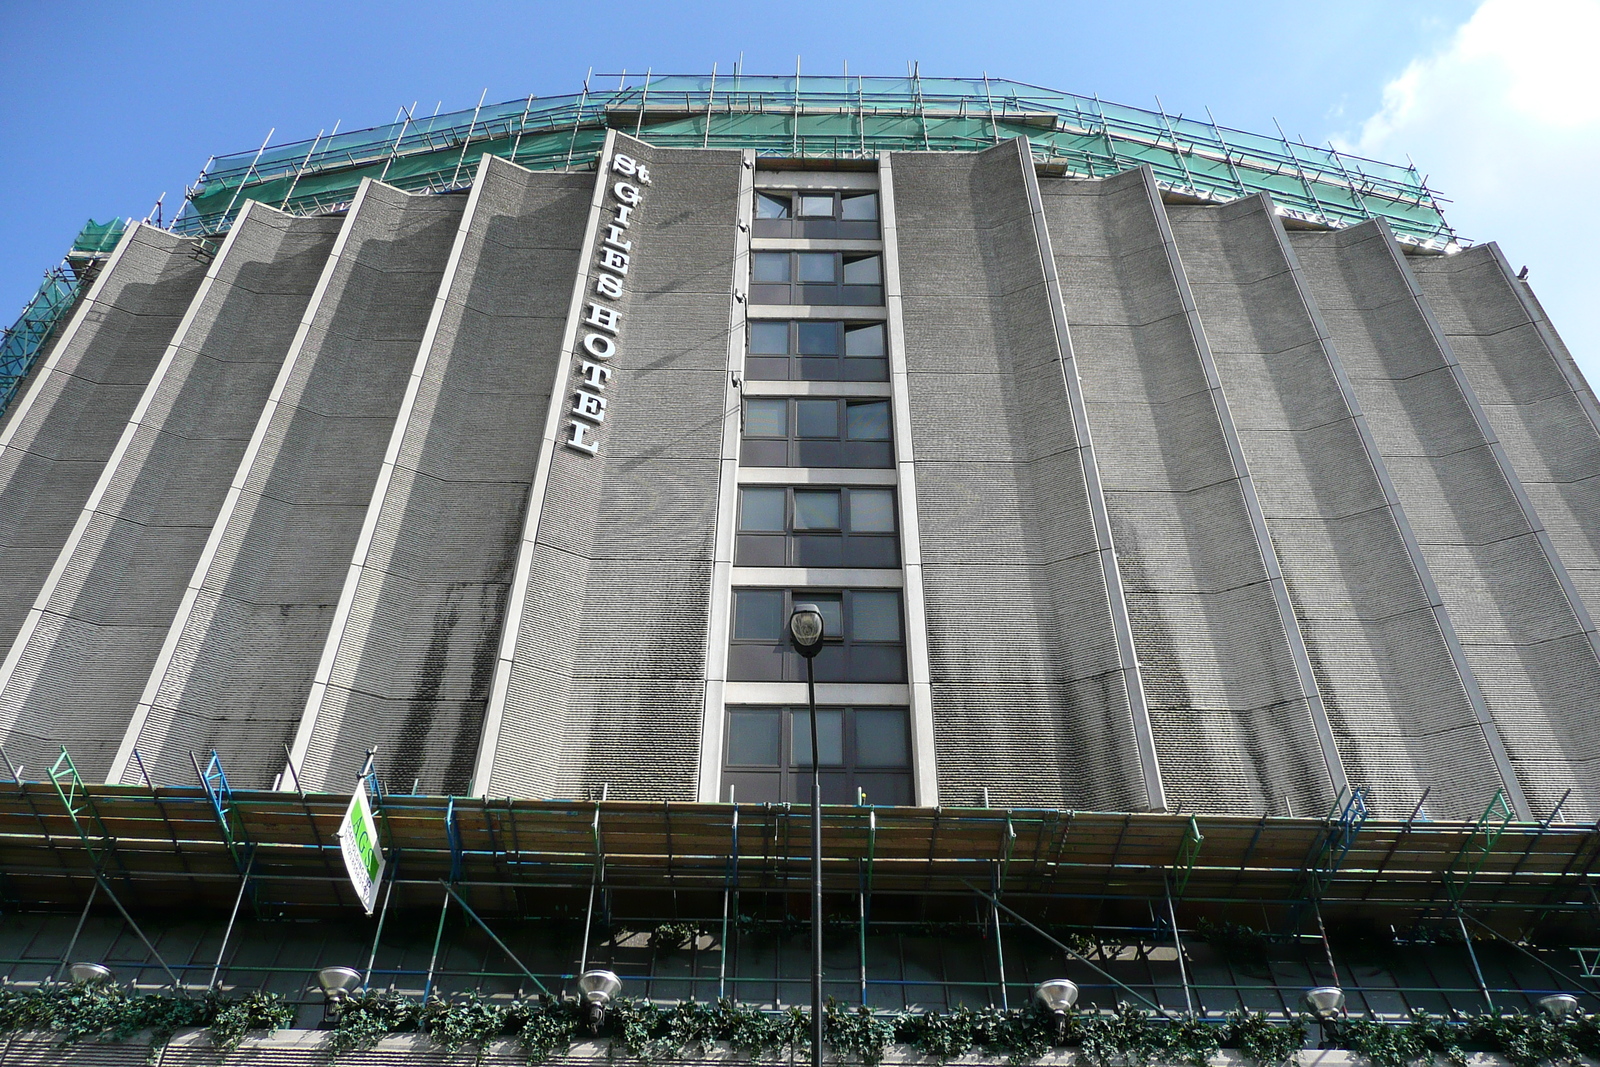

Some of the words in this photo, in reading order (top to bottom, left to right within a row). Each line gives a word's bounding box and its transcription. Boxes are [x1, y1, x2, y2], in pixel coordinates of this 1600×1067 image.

[597, 182, 642, 300] GILES
[567, 302, 622, 455] HOTEL
[353, 816, 374, 868] AGS
